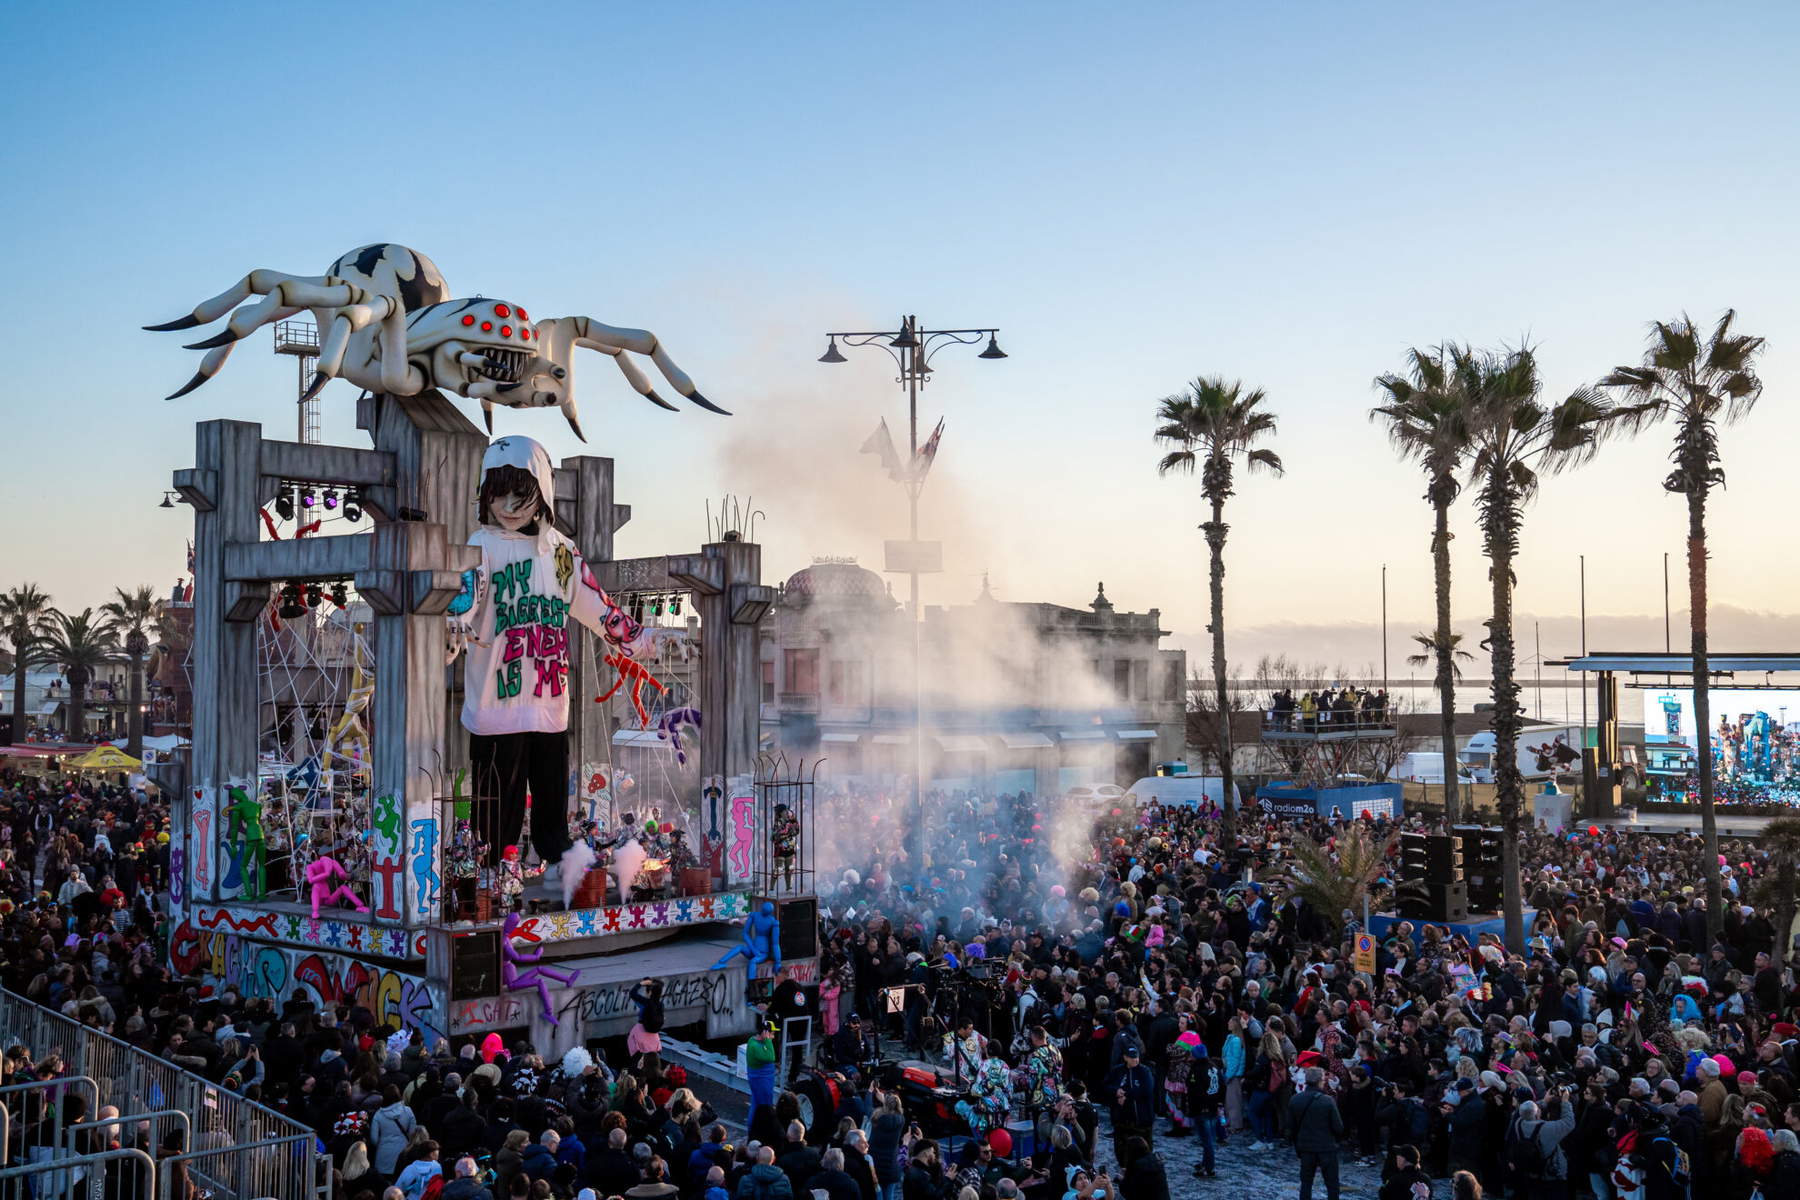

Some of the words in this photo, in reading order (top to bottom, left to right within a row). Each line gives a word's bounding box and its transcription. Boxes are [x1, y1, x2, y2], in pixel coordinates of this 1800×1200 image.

[492, 558, 532, 604] MY
[496, 659, 522, 699] IS
[1273, 803, 1315, 814] radiom2o
